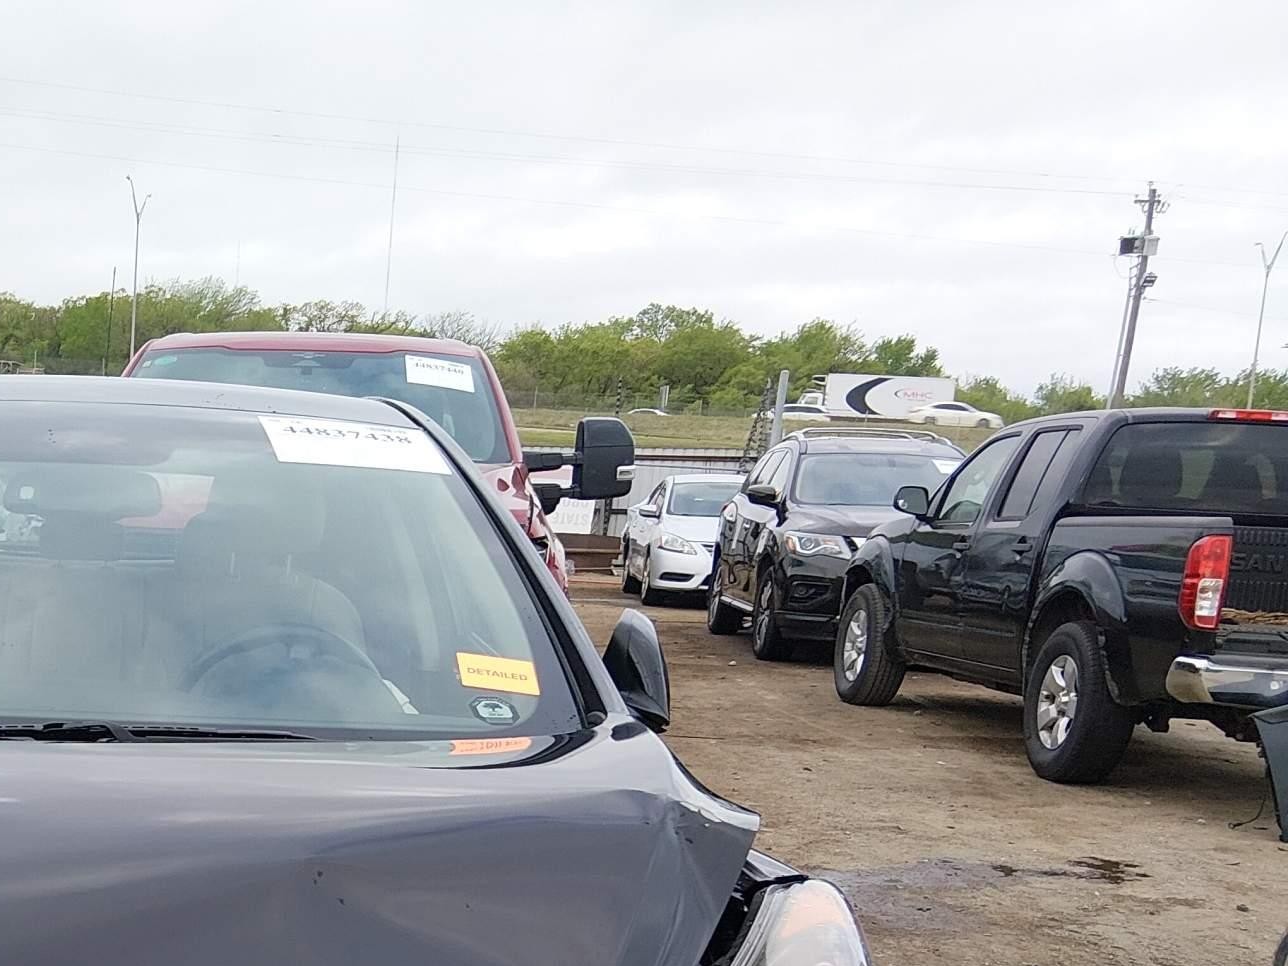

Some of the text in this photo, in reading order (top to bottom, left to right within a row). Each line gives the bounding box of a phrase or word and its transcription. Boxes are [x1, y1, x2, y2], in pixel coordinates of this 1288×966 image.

[903, 390, 934, 400] MHC
[283, 425, 413, 444] 44837438
[466, 667, 528, 681] DETAILED
